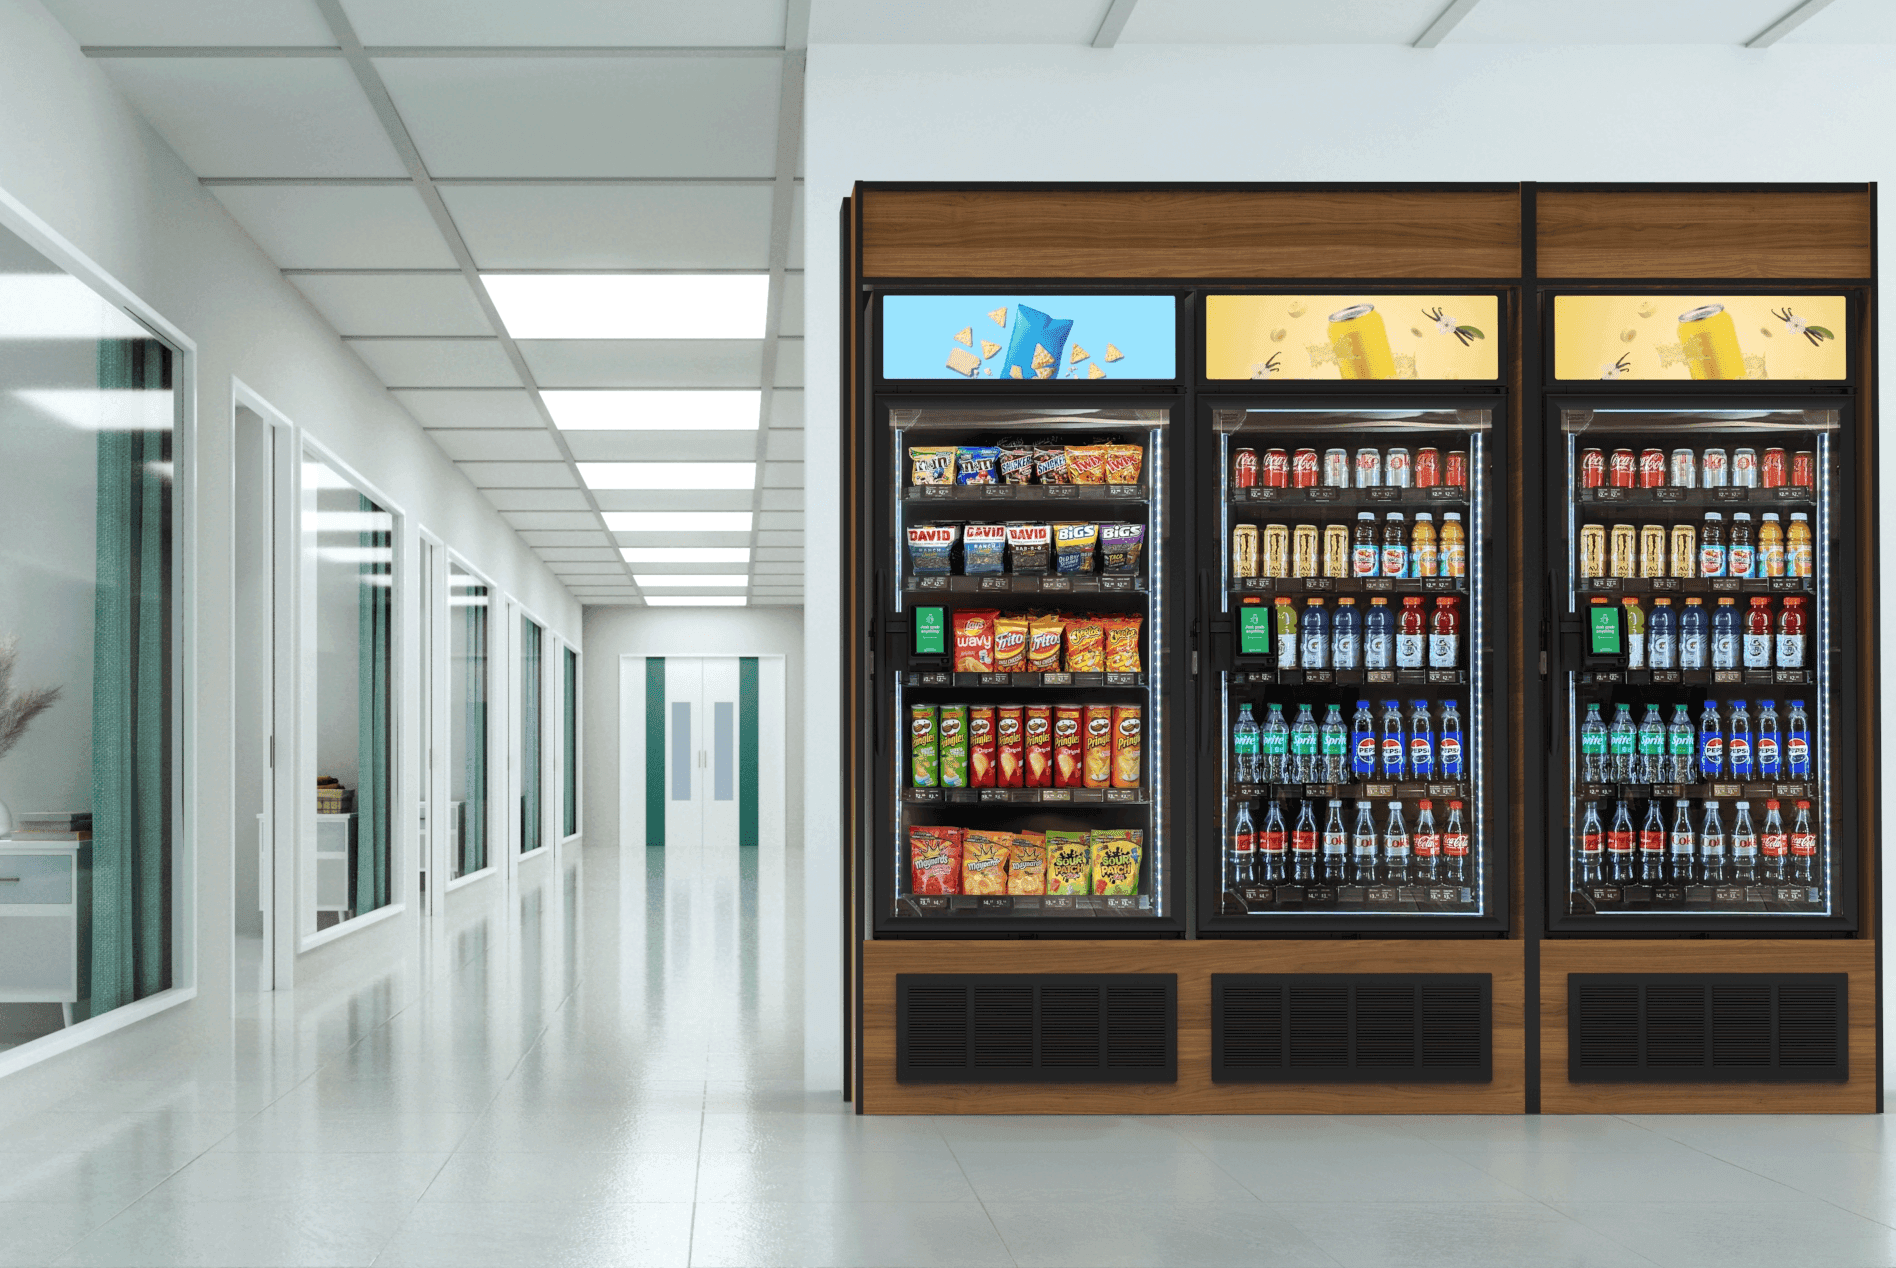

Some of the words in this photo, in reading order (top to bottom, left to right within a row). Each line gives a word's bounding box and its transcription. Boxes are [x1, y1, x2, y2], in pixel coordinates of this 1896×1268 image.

[908, 530, 951, 542] DAVID
[966, 527, 1005, 538] DAVID
[1010, 528, 1047, 540] DAVID
[957, 635, 992, 649] wavy
[1102, 856, 1130, 865] SOUR
[1101, 864, 1131, 874] PATCH
